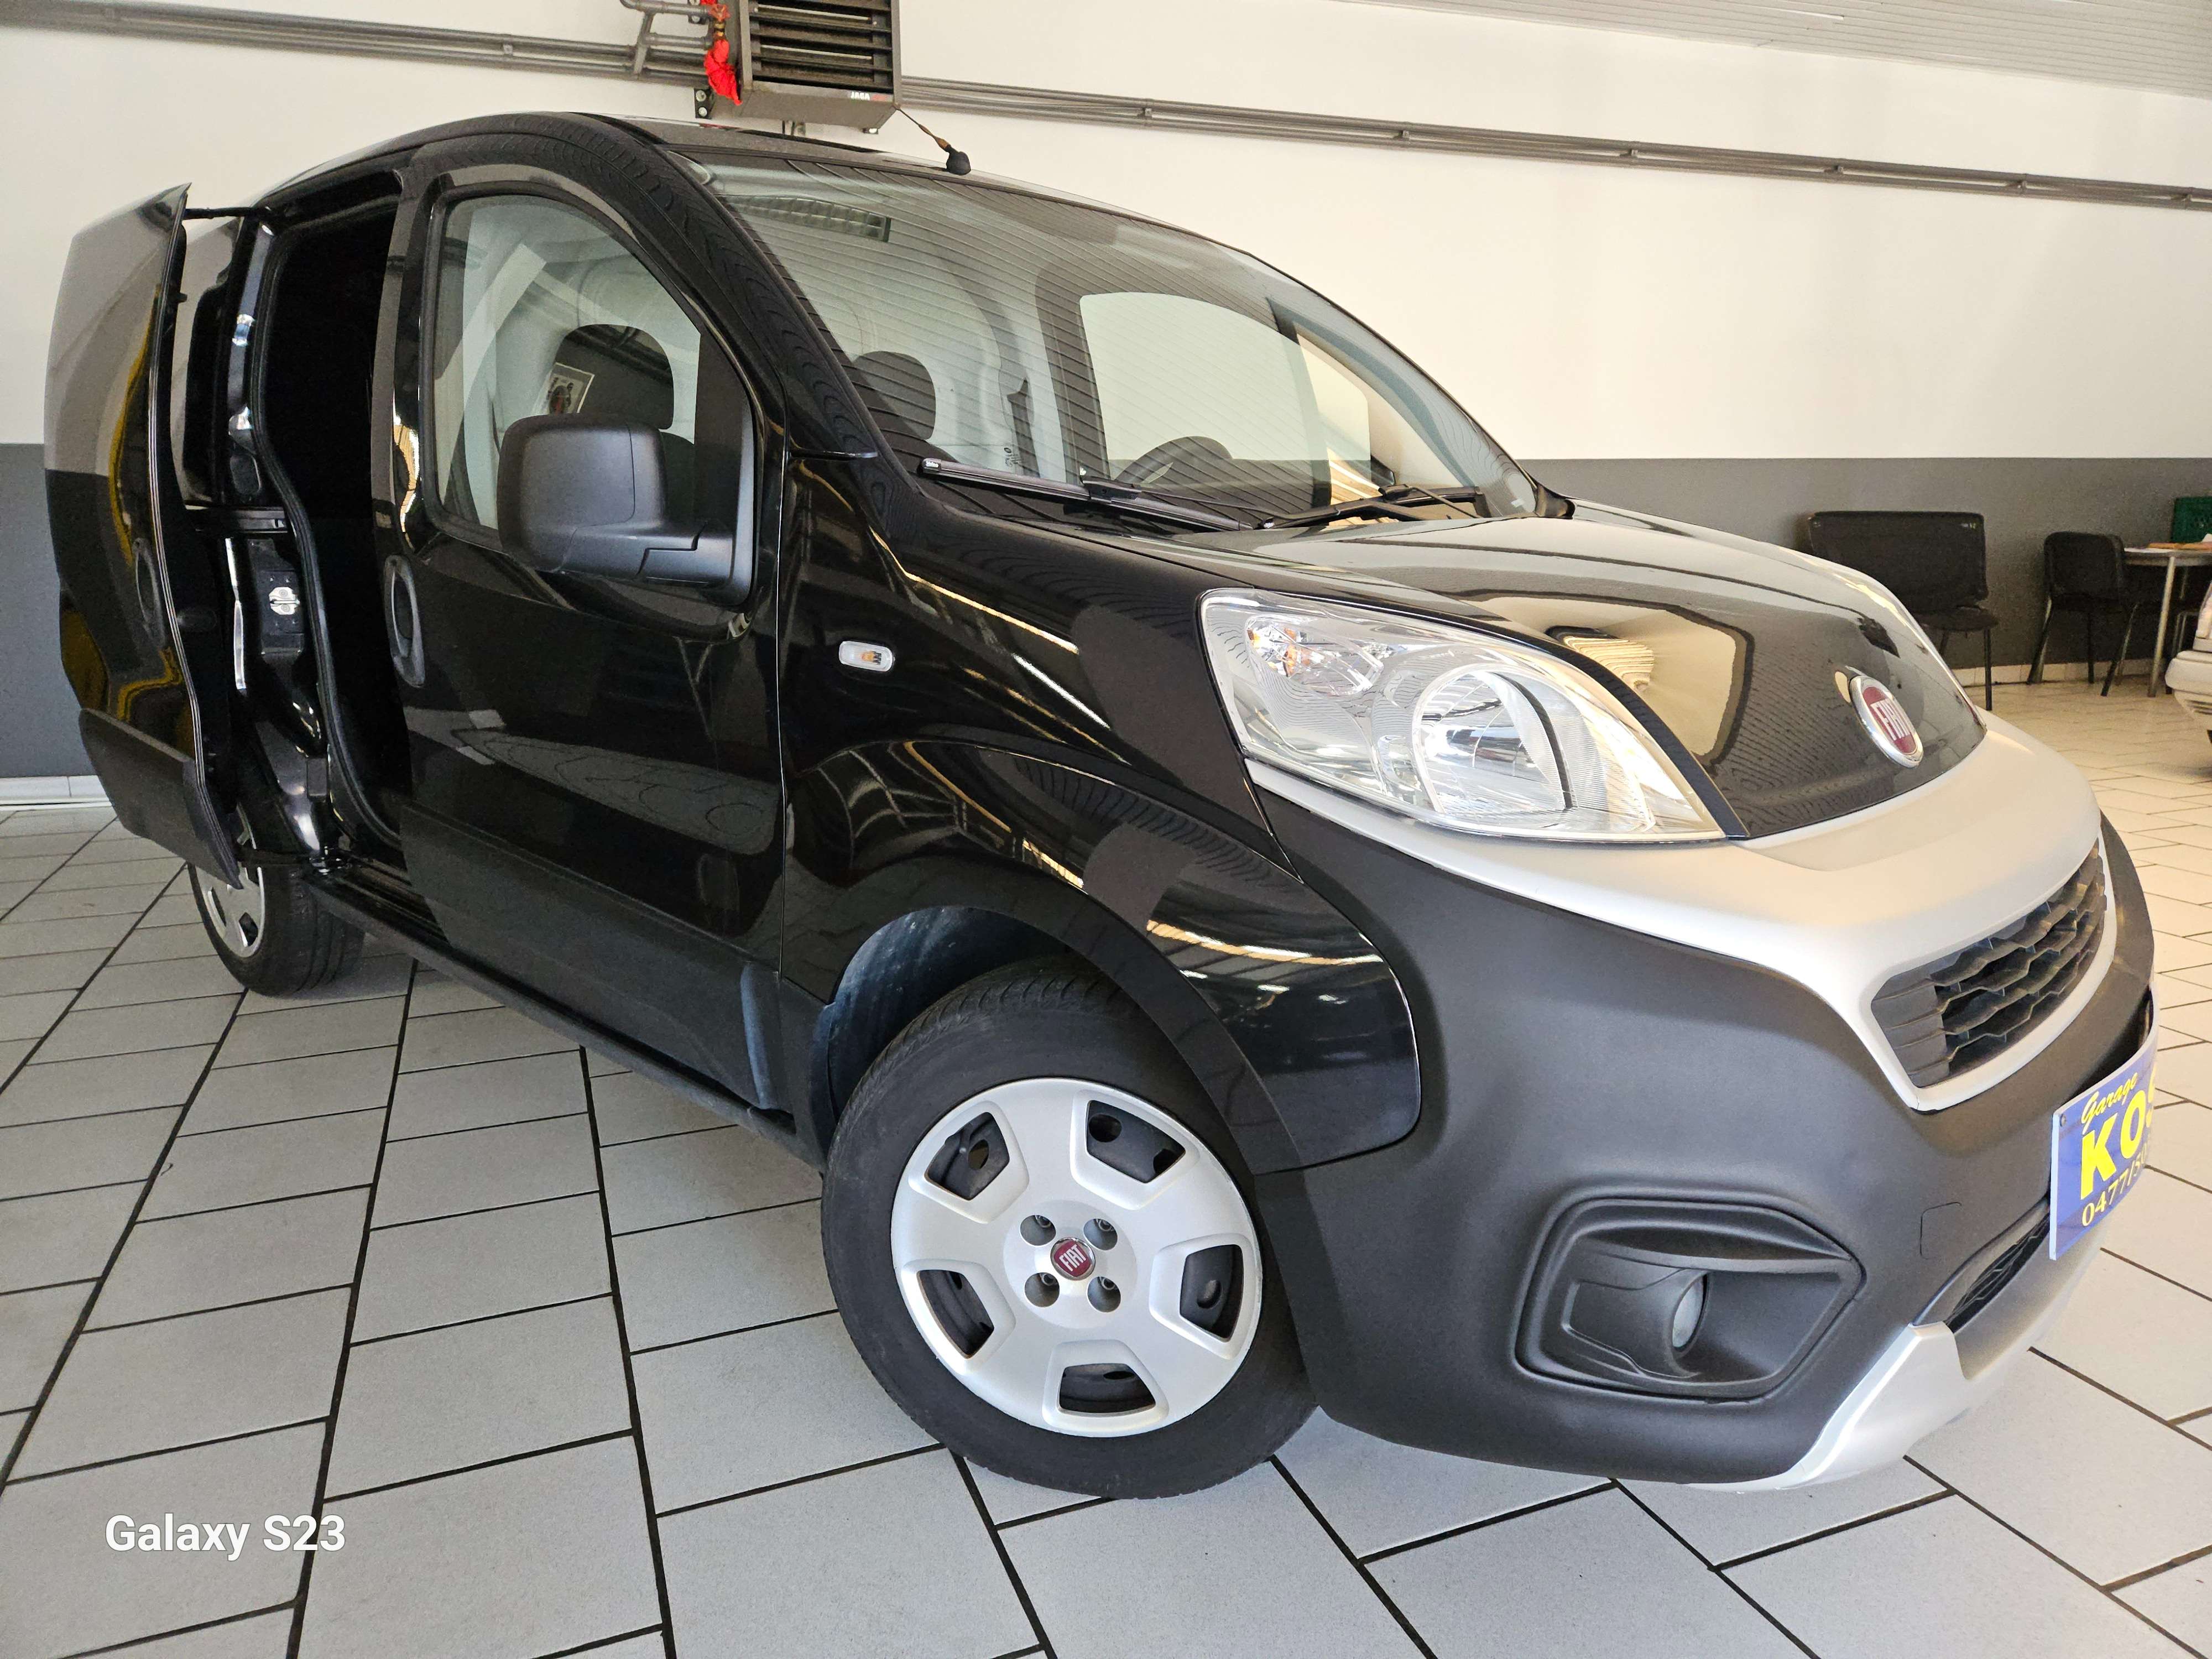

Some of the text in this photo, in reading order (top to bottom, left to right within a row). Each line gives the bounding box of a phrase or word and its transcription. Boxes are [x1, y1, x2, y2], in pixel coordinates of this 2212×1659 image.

[1870, 698, 1911, 741] FIAT
[2081, 1072, 2137, 1135] Garage
[1059, 1244, 1086, 1272] FIAT
